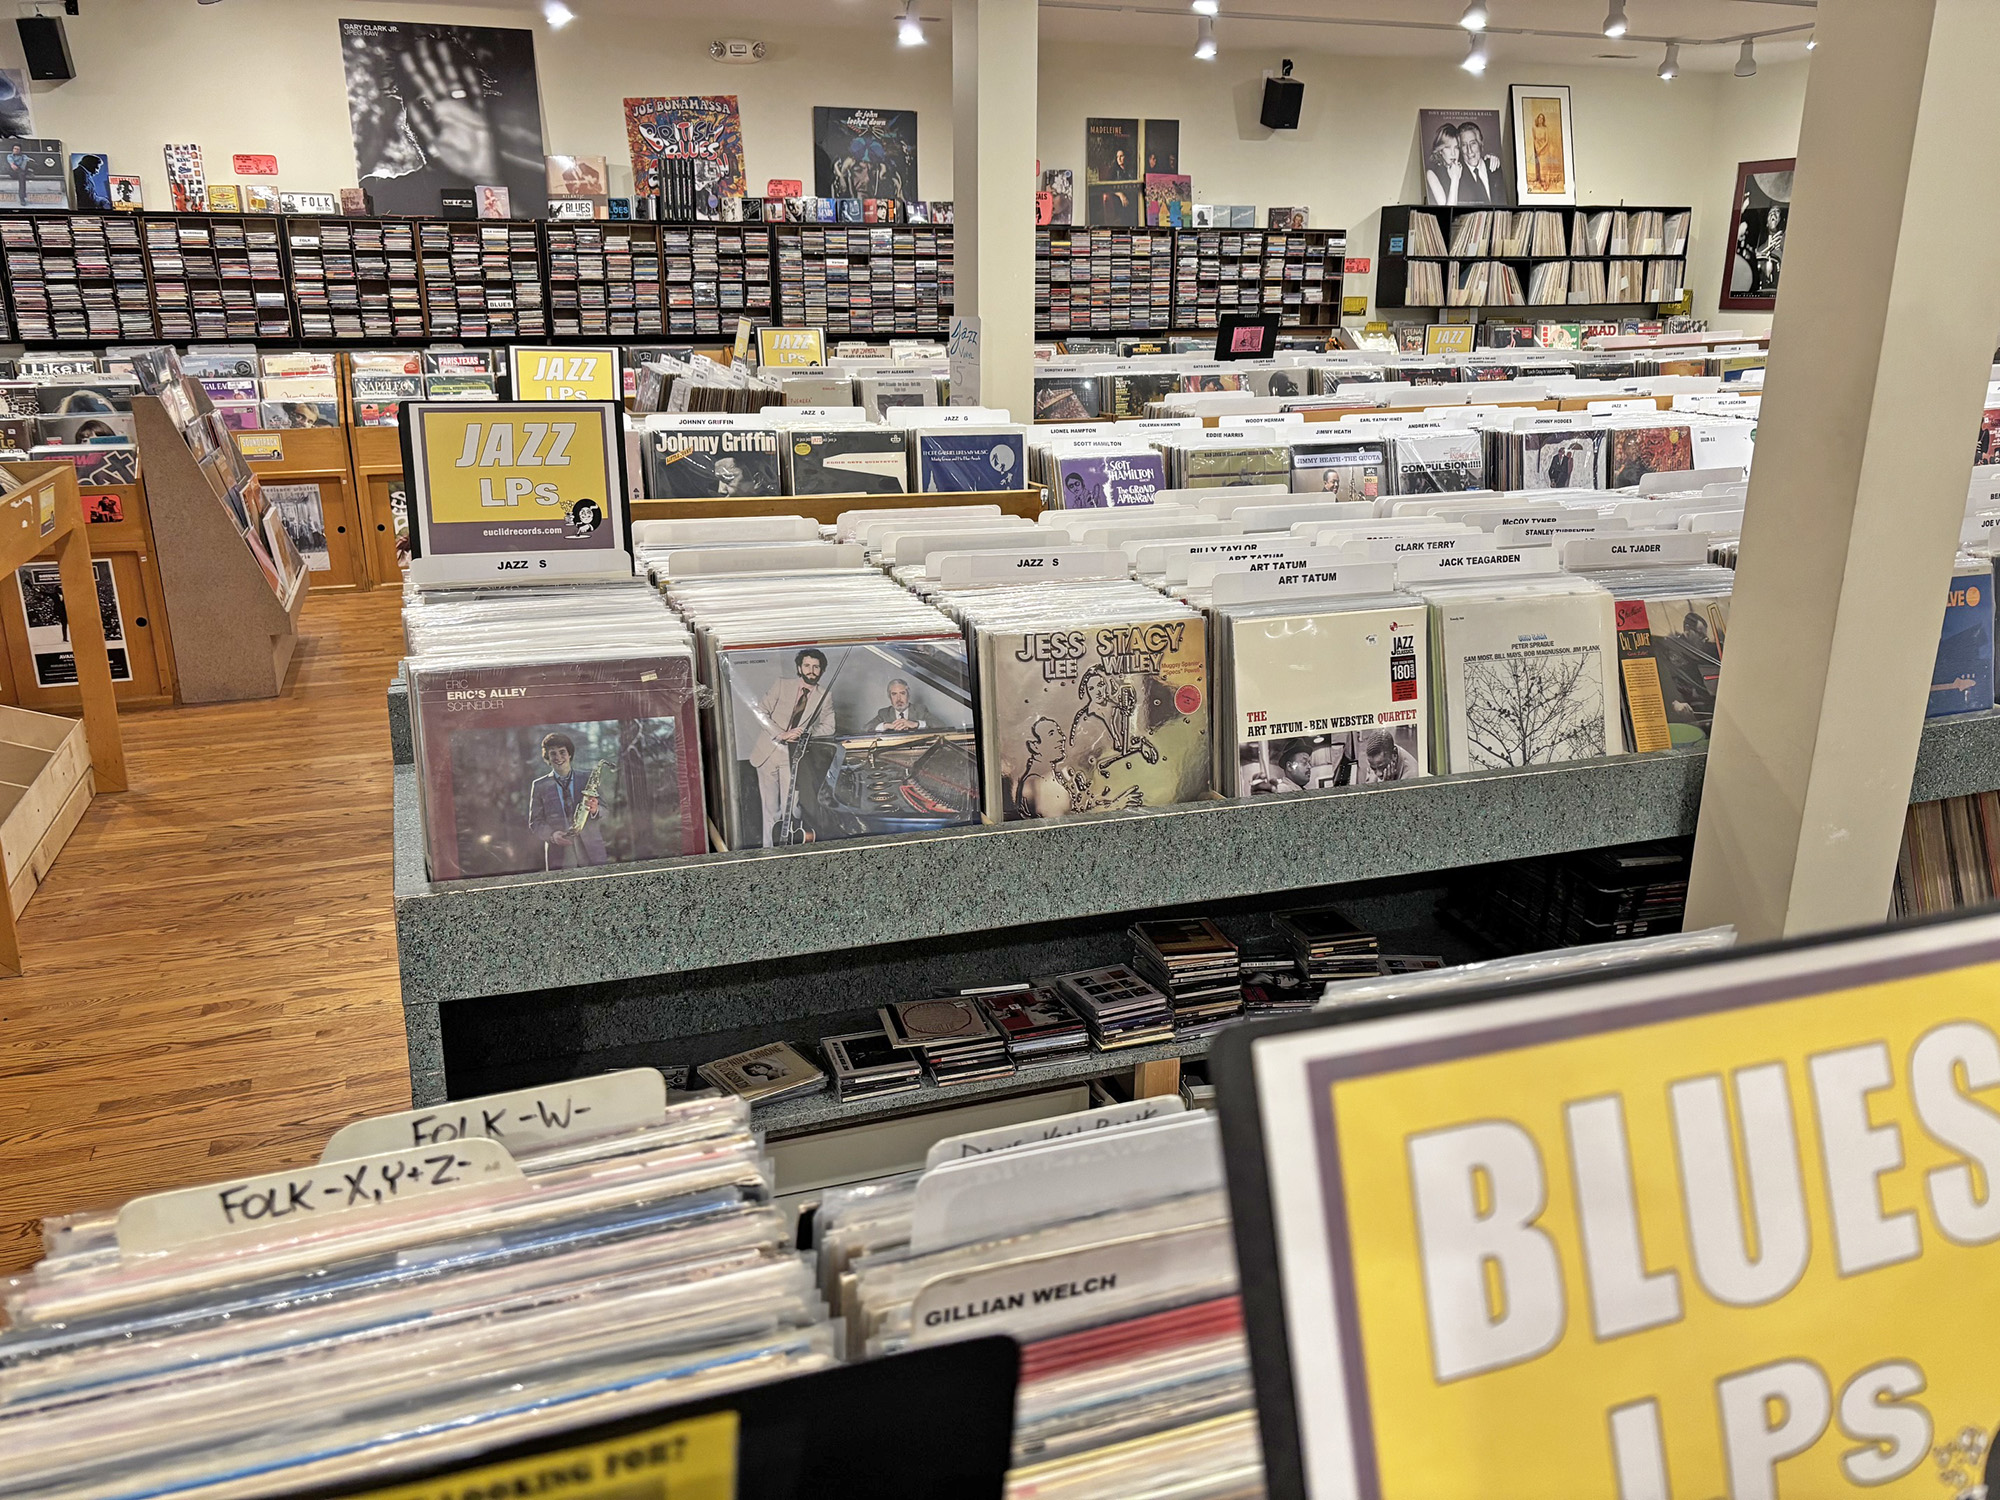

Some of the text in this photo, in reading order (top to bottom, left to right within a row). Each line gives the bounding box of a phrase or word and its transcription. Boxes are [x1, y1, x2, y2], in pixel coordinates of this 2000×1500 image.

[364, 24, 387, 32] CLARK
[633, 99, 731, 118] JOE BONAMASSA
[864, 110, 878, 119] john
[868, 117, 886, 126] down
[638, 121, 724, 153] BRITISH
[1090, 126, 1122, 135] MADELEINE
[301, 196, 331, 208] FOLK
[565, 202, 591, 213] BLUES
[1435, 330, 1466, 344] JAZZ
[1587, 325, 1616, 336] MAD
[772, 334, 811, 350] JAZZ
[950, 320, 978, 355] Jazz
[780, 353, 806, 364] LPs
[32, 362, 72, 374] Like
[533, 357, 598, 382] JAZZ
[360, 380, 415, 393] NAPOLEON
[546, 386, 588, 400] LPs
[455, 422, 577, 468] JAZZ
[656, 431, 776, 455] Johnny Griffin
[1109, 460, 1130, 470] SCOTT
[1296, 456, 1317, 464] JIMMY
[1358, 454, 1381, 462] QUOTA
[479, 478, 560, 507] LPs
[1116, 486, 1128, 494] The
[1502, 518, 1530, 526] McCOY
[1981, 520, 1994, 528] JOE
[483, 526, 562, 537] euclidrecords.com
[1525, 528, 1554, 536] STANLEY
[1394, 540, 1456, 552] CLARK TERRY
[1611, 544, 1661, 554] CAL TJADER
[497, 559, 547, 570] JAZZ S
[1017, 558, 1060, 568] JAZZ S
[1250, 560, 1307, 572] ART TATUM
[1438, 554, 1521, 567] JACK TEAGARDEN
[1278, 572, 1338, 585] ART TATUM
[1016, 622, 1186, 662] JESS STACY
[1391, 636, 1414, 656] JAZZ
[1511, 640, 1554, 650] PETER SPRAGUE
[1478, 654, 1493, 662] MOST,
[1494, 652, 1506, 660] BILL
[1524, 650, 1534, 658] BOB
[1536, 647, 1571, 656] MAGNUSSON,
[1572, 646, 1581, 654] JIM
[1043, 652, 1164, 682] LEE WILEY
[1392, 664, 1410, 680] 180
[446, 679, 468, 690] ERIC
[447, 688, 528, 700] ERIC'S ALLEY
[447, 700, 504, 712] SCHNEIDER
[1246, 710, 1268, 723] THE
[1248, 709, 1418, 737] ART WEBSTER QUARTET
[726, 1044, 784, 1067] NINA SIMONE
[412, 1098, 592, 1147] FOLK -W-
[218, 1179, 315, 1224] FOLK
[1405, 1018, 2000, 1386] BLUES
[924, 1273, 1118, 1328] GILLIAN WELCH
[1606, 1356, 1934, 1500] LPs
